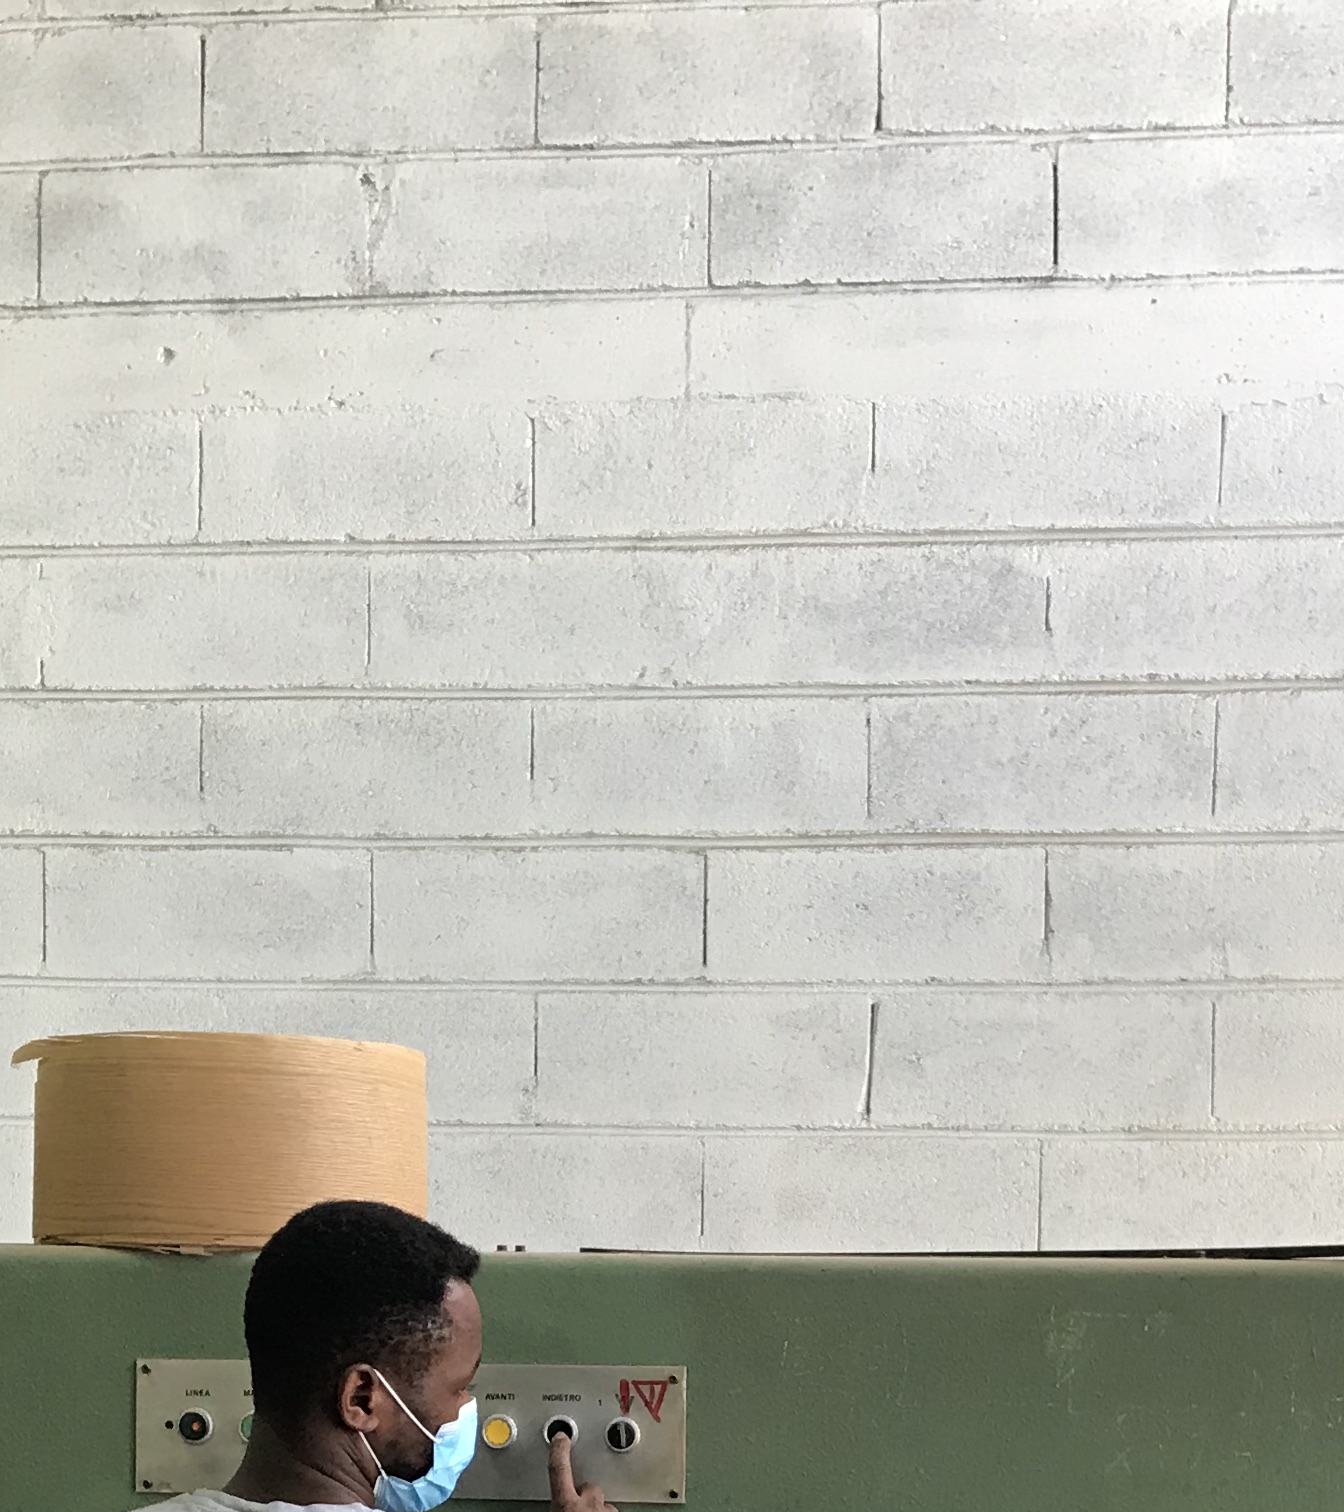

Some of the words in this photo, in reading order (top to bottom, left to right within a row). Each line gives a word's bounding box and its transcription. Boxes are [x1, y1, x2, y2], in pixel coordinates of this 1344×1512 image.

[185, 1389, 211, 1397] LINEA
[485, 1392, 515, 1401] AVANTI
[542, 1394, 582, 1402] INDIETRO
